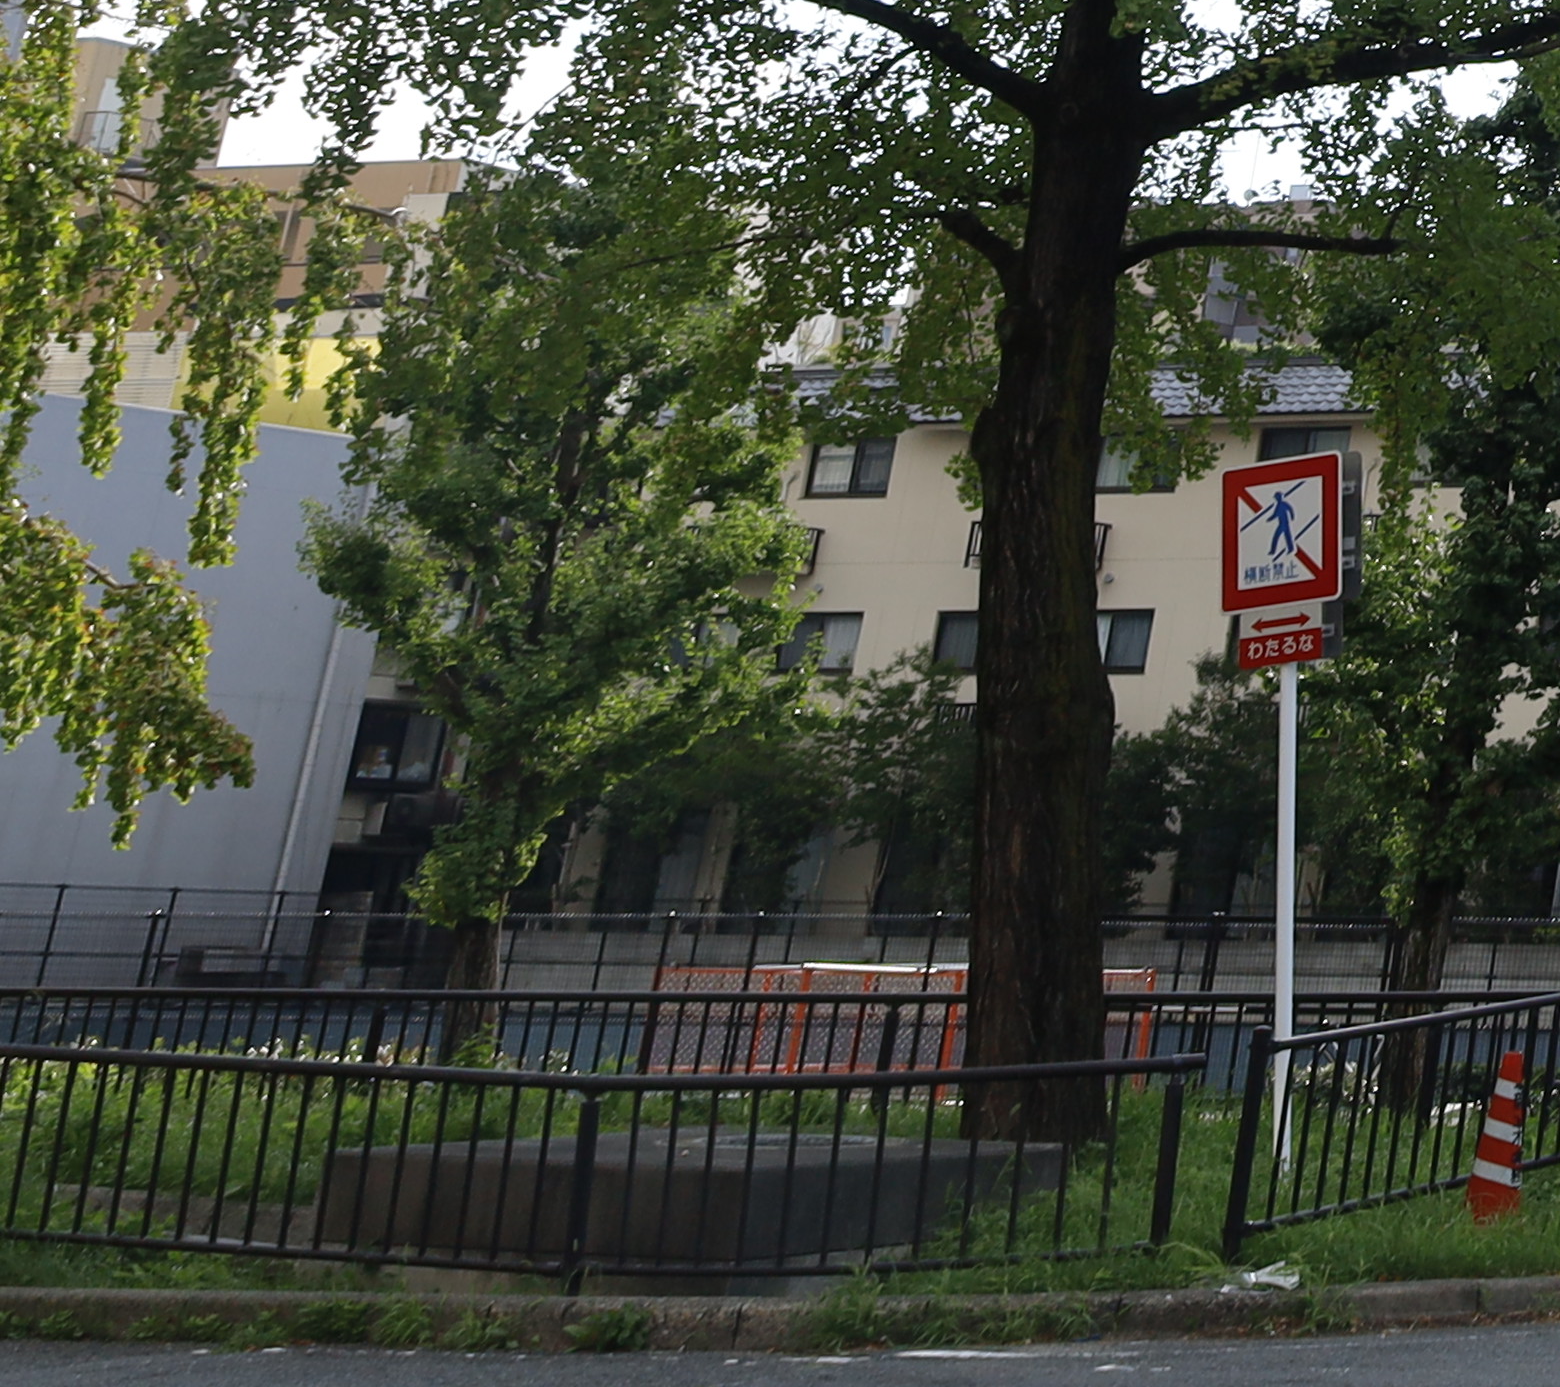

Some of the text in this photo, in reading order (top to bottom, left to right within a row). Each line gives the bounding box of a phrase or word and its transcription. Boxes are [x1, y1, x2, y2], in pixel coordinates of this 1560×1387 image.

[1244, 562, 1299, 584] 横断禁止
[1248, 634, 1314, 660] わたるな
